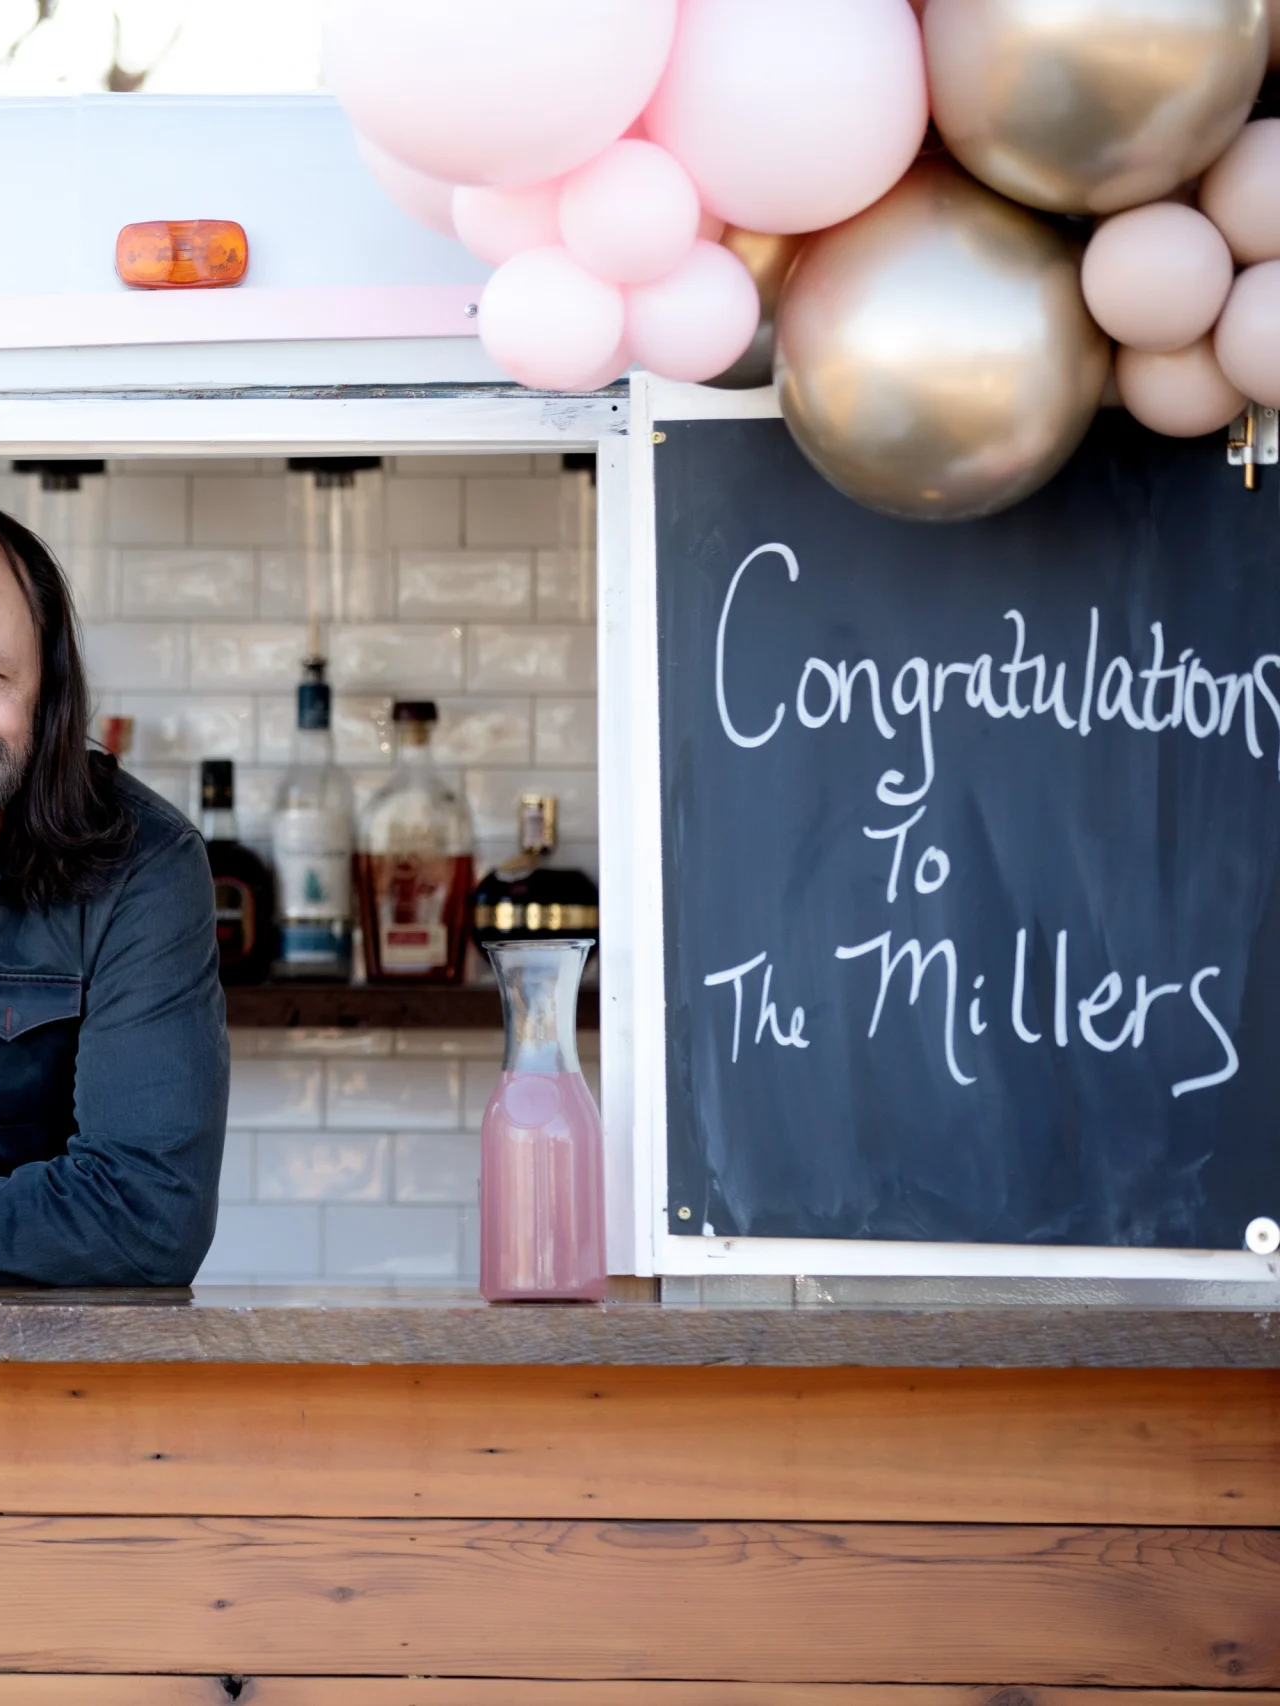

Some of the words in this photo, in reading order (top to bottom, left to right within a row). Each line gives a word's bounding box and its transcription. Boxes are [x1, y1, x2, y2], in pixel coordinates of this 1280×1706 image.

[715, 542, 1280, 806] Congratulations
[862, 805, 951, 904] To
[703, 950, 811, 1064] The
[834, 927, 1240, 1098] Millers
